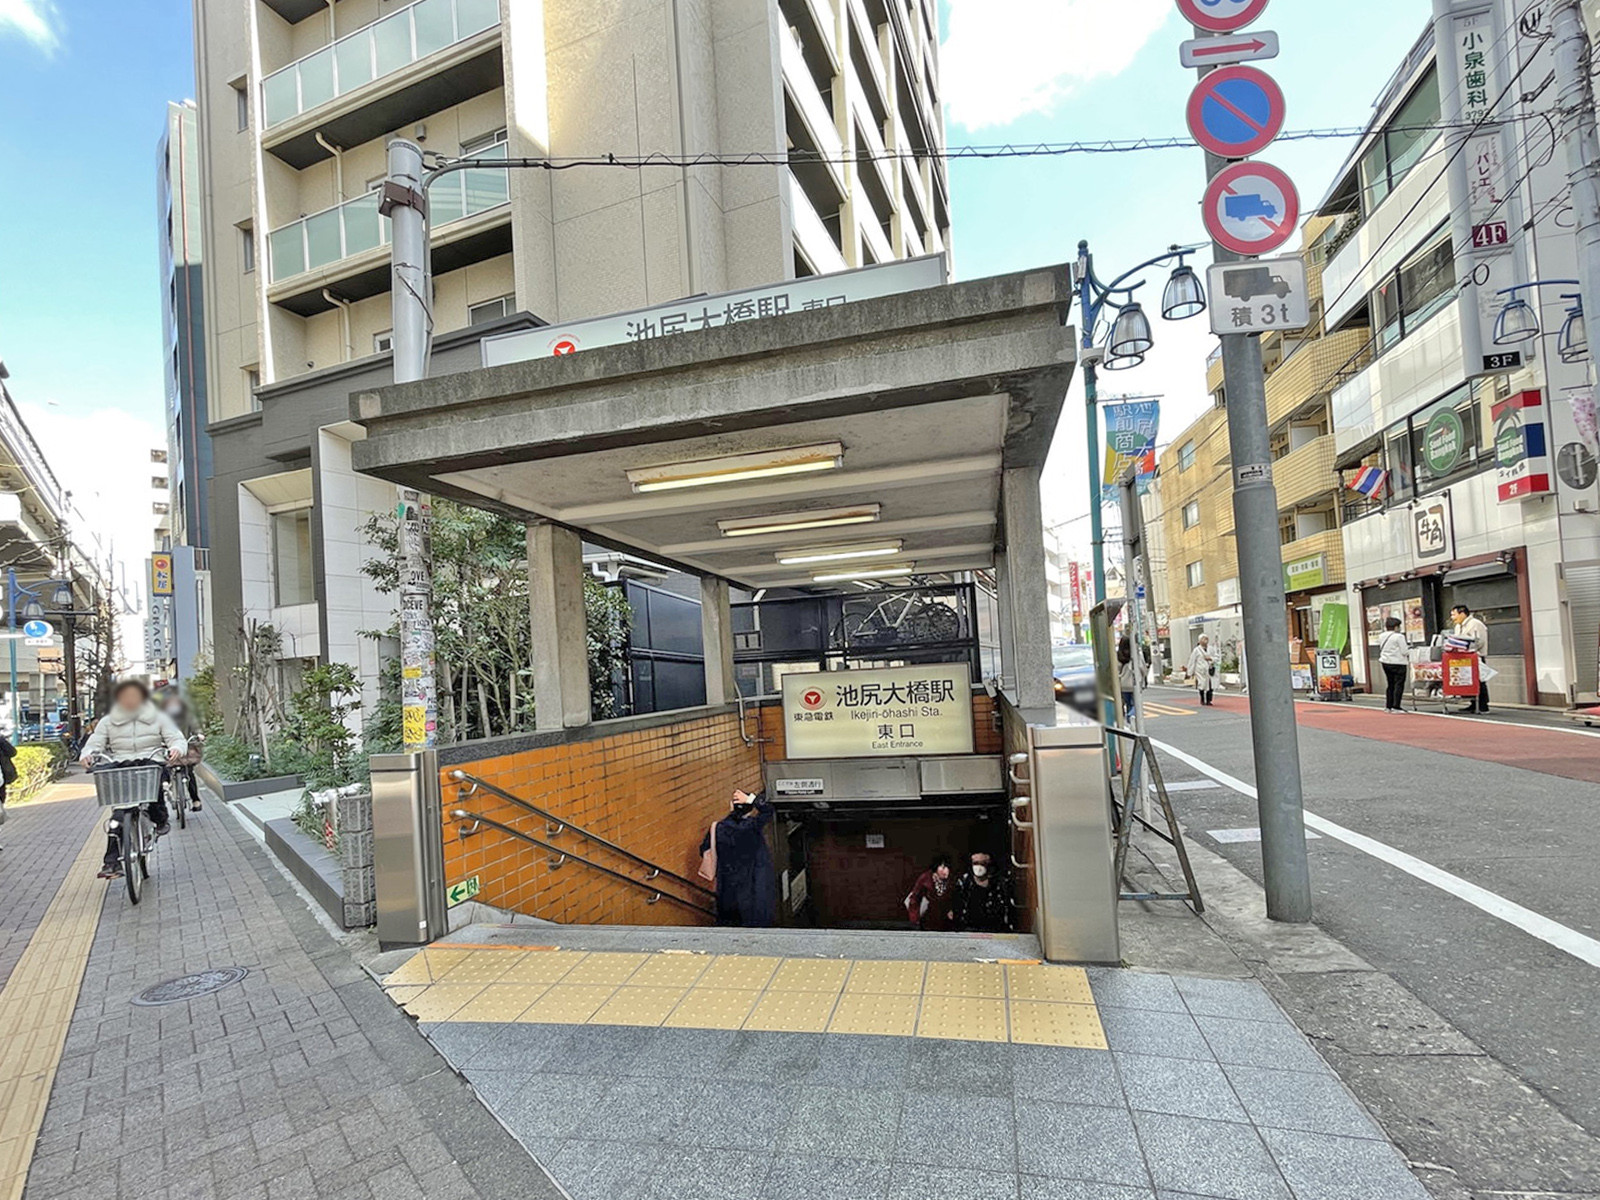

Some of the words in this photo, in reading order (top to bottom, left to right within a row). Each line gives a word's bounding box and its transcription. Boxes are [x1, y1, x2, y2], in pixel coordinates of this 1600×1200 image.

[1462, 32, 1488, 108] 小泉歯科
[1475, 223, 1506, 246] 4F
[1490, 355, 1513, 368] 3F
[1420, 518, 1443, 545] 牛角
[152, 604, 162, 656] GRACE
[836, 679, 955, 707] 池尻大橋駅
[793, 711, 834, 722] 東急電鉄
[921, 706, 943, 717] Sta.
[877, 723, 915, 740] 東口
[872, 741, 889, 749] East
[890, 740, 924, 748] Entrance
